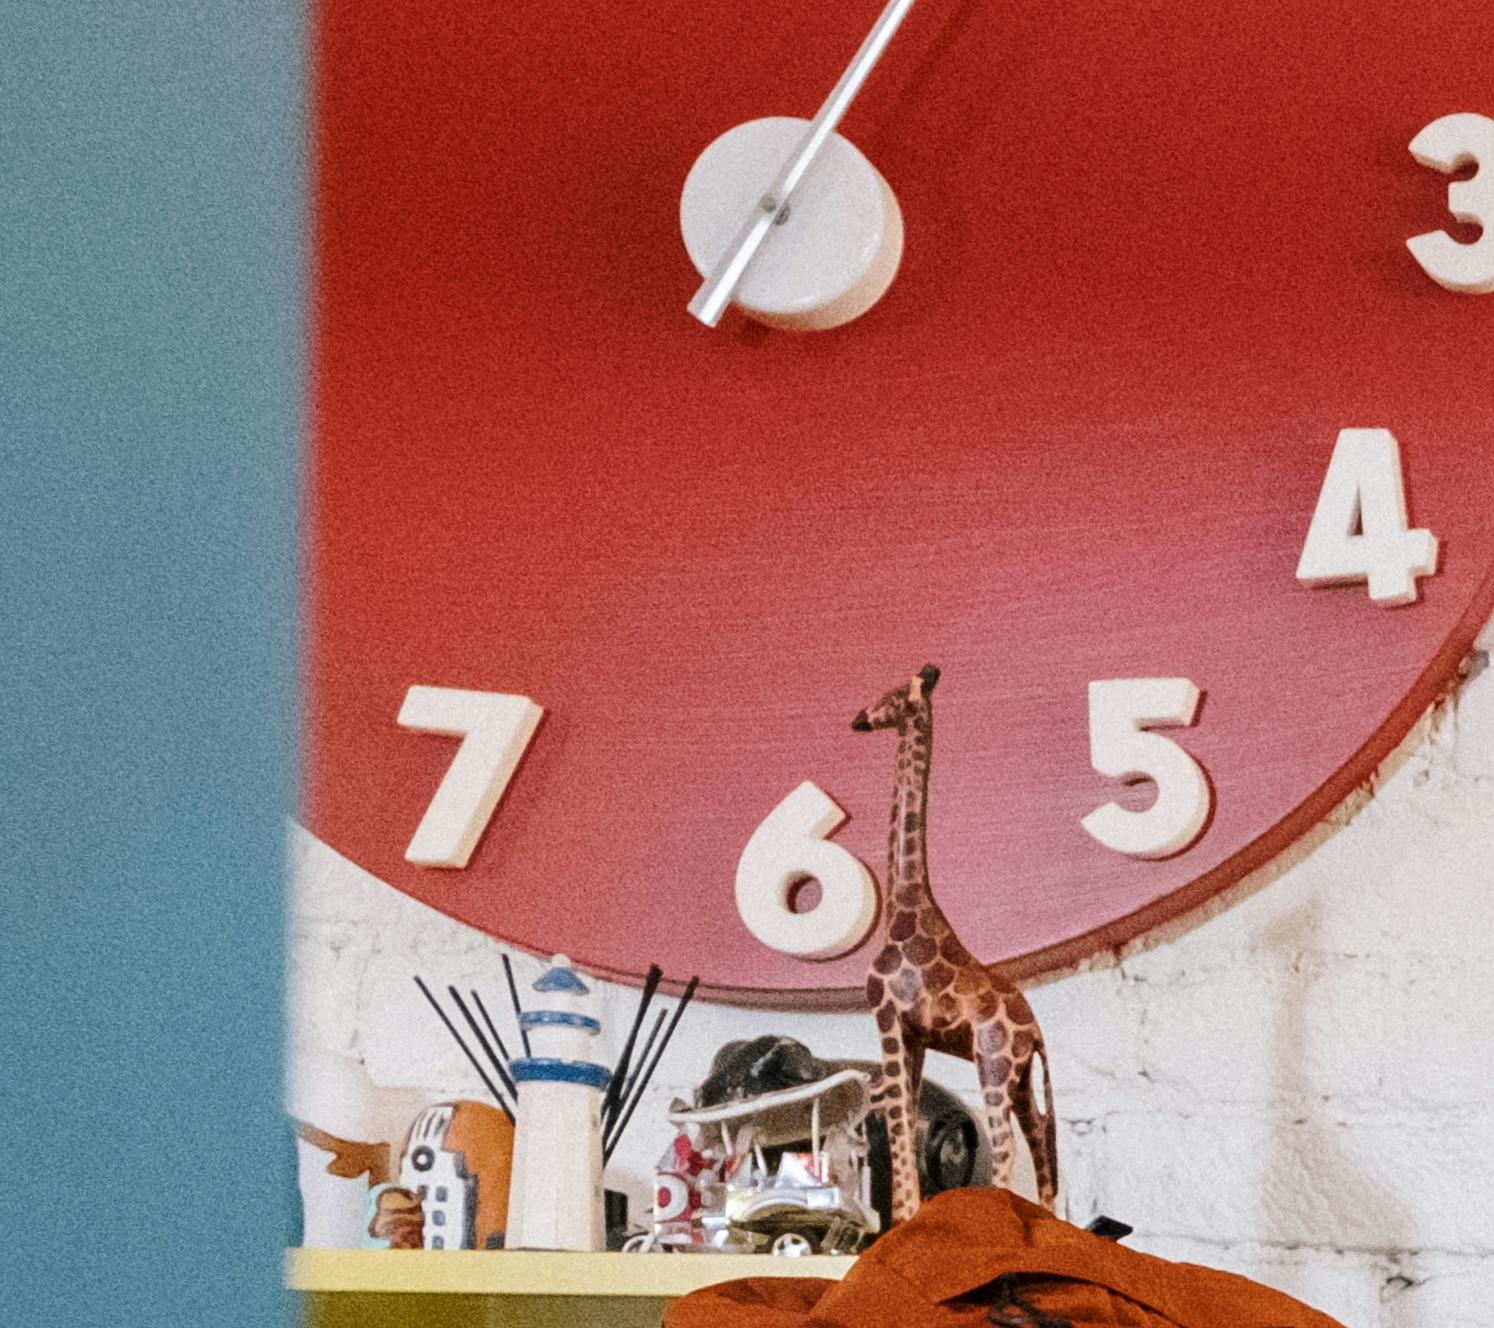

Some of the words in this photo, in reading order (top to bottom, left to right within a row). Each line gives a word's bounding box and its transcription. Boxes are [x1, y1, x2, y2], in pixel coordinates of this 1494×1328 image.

[1295, 428, 1438, 606] 4
[396, 684, 545, 870] 7
[1079, 677, 1212, 860] 5
[735, 780, 876, 961] 6
